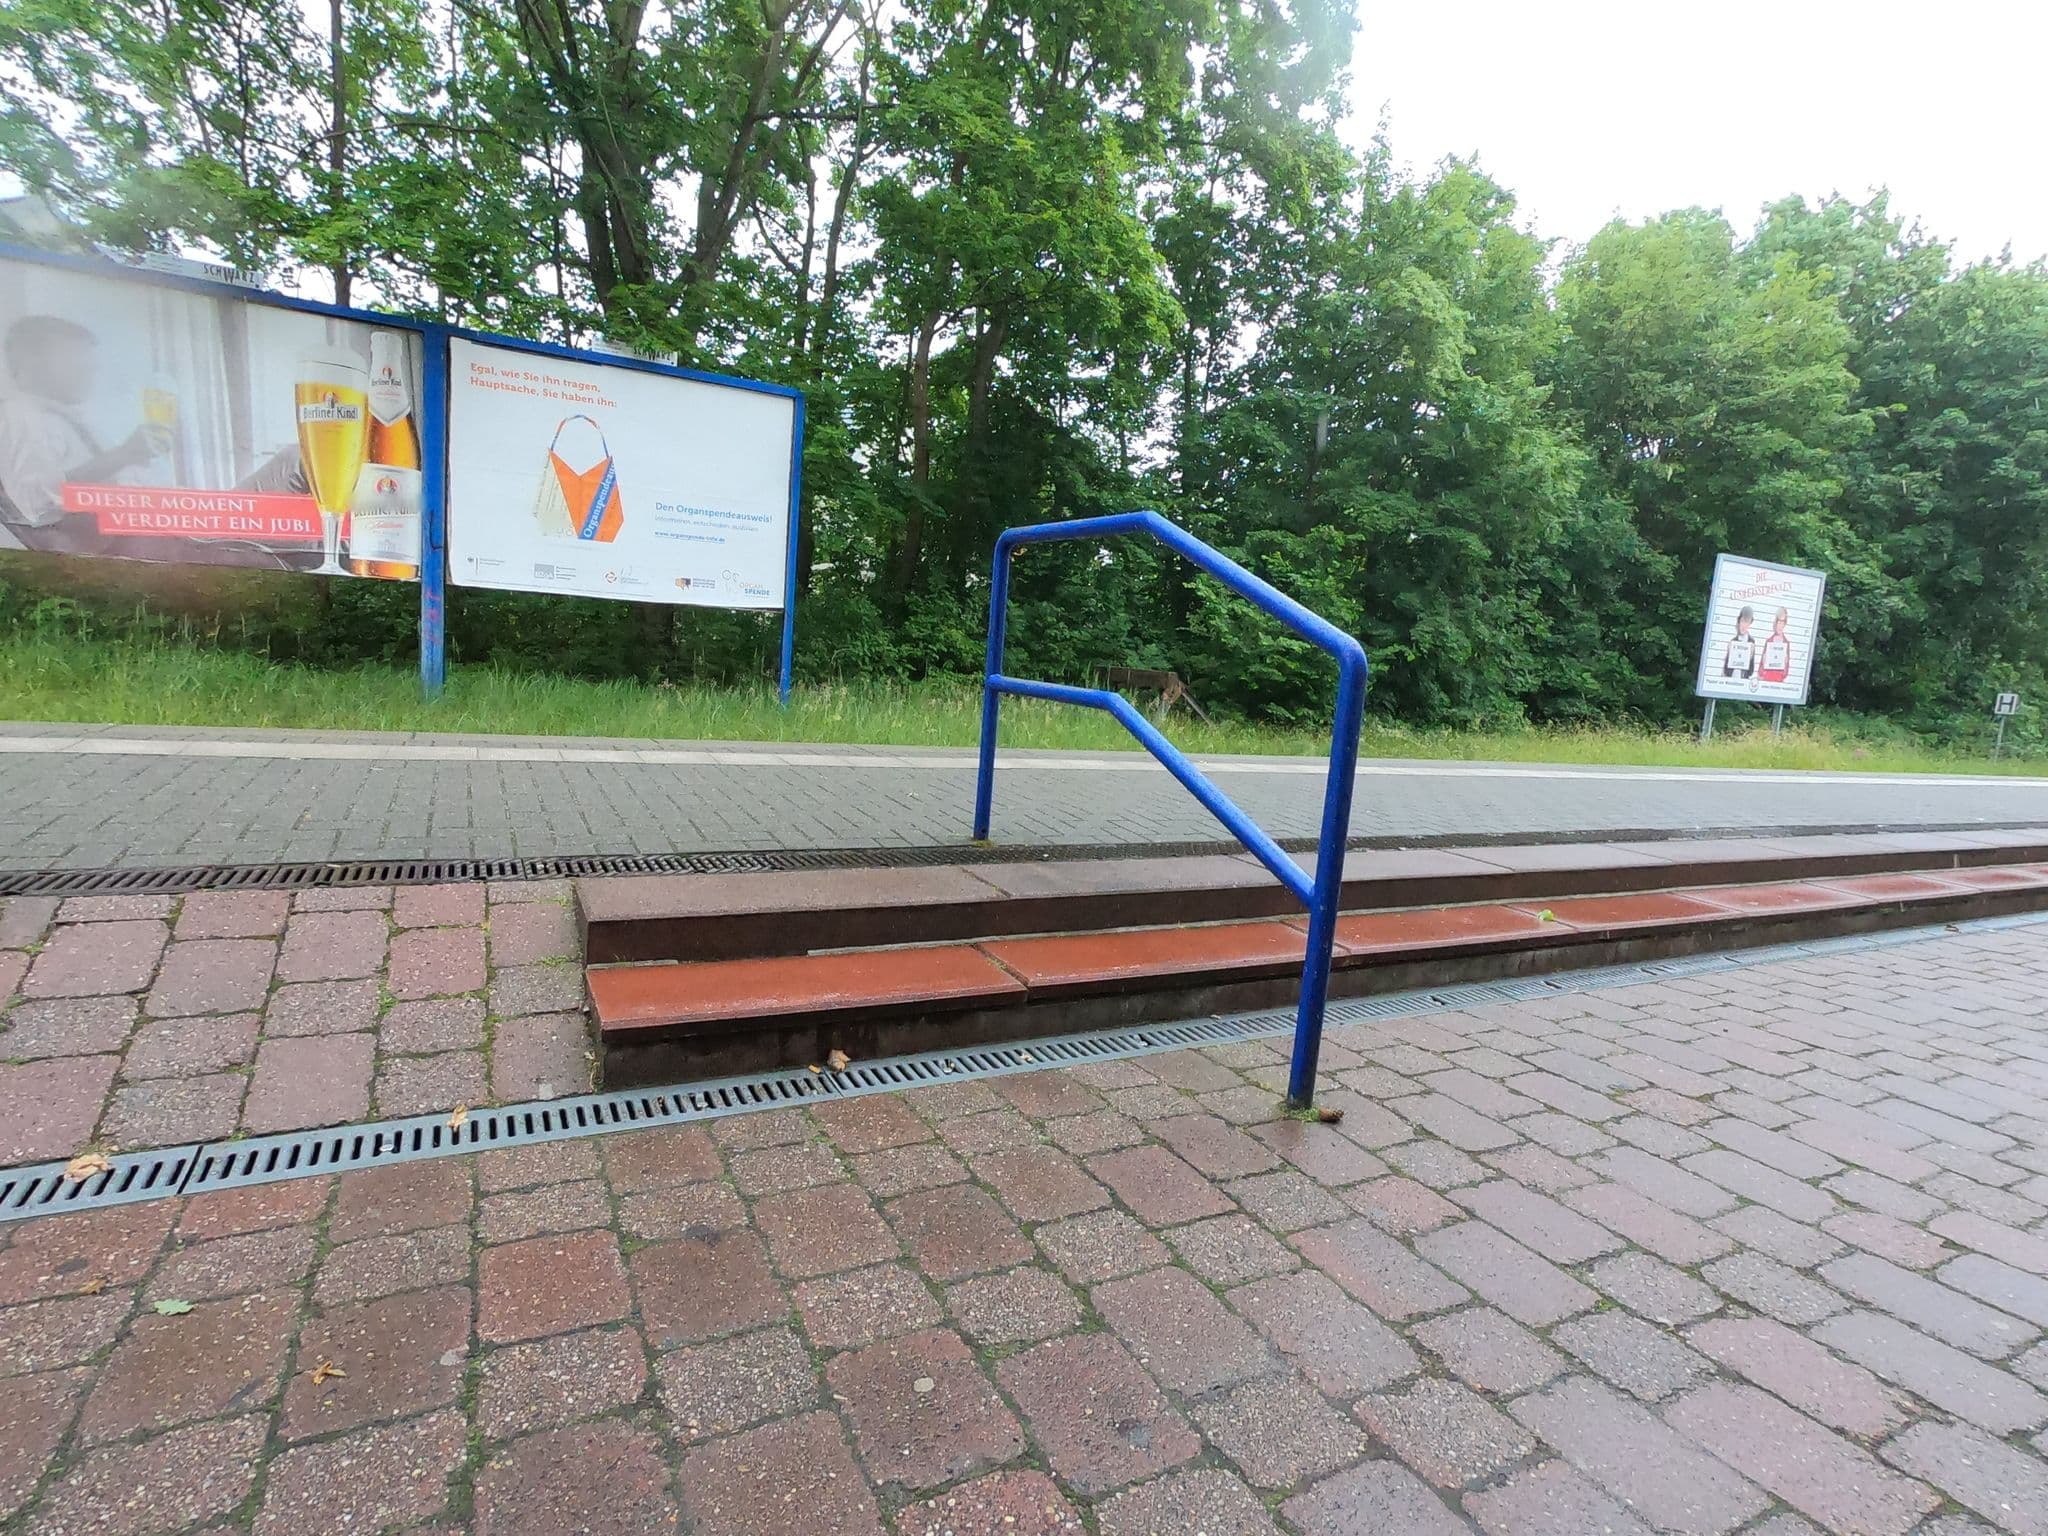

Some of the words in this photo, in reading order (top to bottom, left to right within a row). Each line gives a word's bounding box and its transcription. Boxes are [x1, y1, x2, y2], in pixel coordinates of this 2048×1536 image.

[470, 363, 498, 376] Egal,
[501, 369, 521, 379] wie
[523, 372, 540, 382] Sie
[542, 375, 561, 386] ihn
[563, 379, 601, 393] tragen,
[470, 376, 540, 396] Hauptsache,
[542, 388, 559, 398] Sie
[561, 391, 595, 405] haben
[303, 406, 334, 419] Berliner
[336, 406, 358, 419] Kindl
[76, 491, 153, 508] DIESER
[161, 496, 258, 513] MOMENT
[655, 502, 674, 511] Den
[676, 504, 773, 523] Organspendeausweis!
[111, 512, 223, 530] VERDIENT
[229, 515, 264, 531] EIN
[1996, 695, 2015, 712] H
